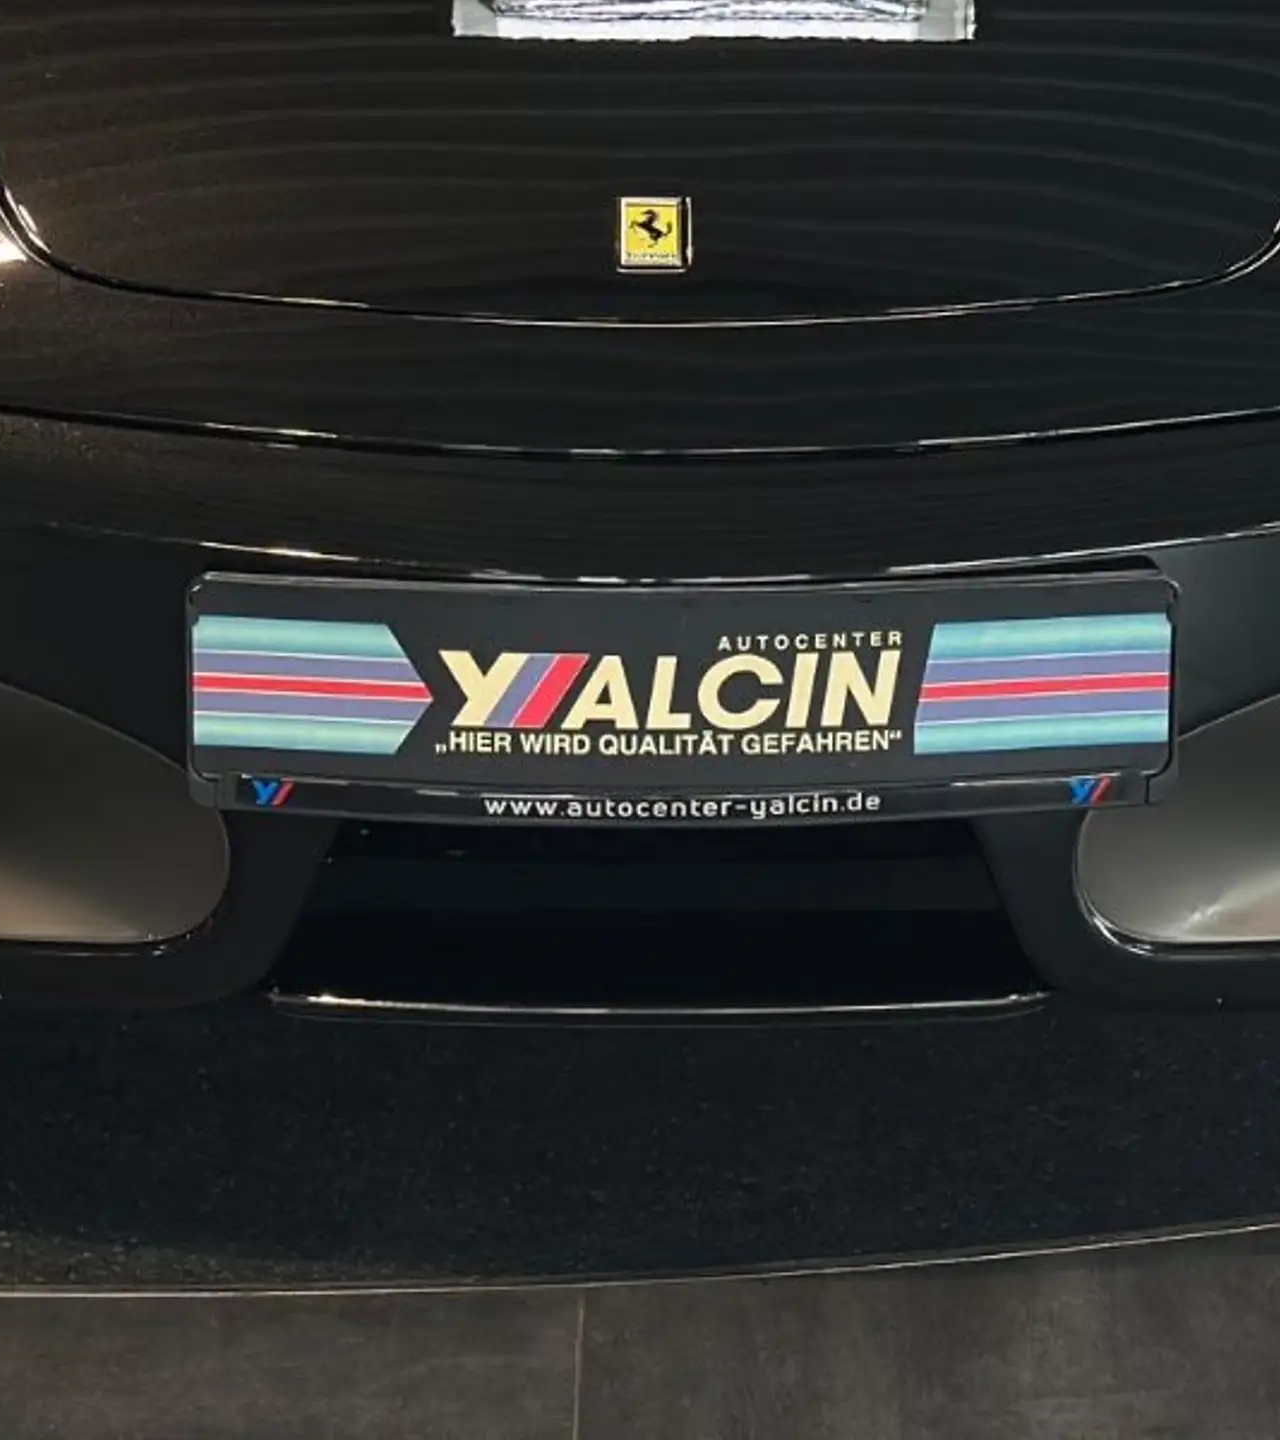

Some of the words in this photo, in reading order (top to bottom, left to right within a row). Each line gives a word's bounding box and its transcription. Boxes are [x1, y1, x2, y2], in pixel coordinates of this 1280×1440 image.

[717, 630, 904, 651] AUTOCENTER
[438, 649, 902, 731] YALCIN
[521, 733, 591, 755] WIRD
[599, 730, 735, 756] QUALITÄT
[483, 791, 882, 820] www.autocenter-yalcin.de
